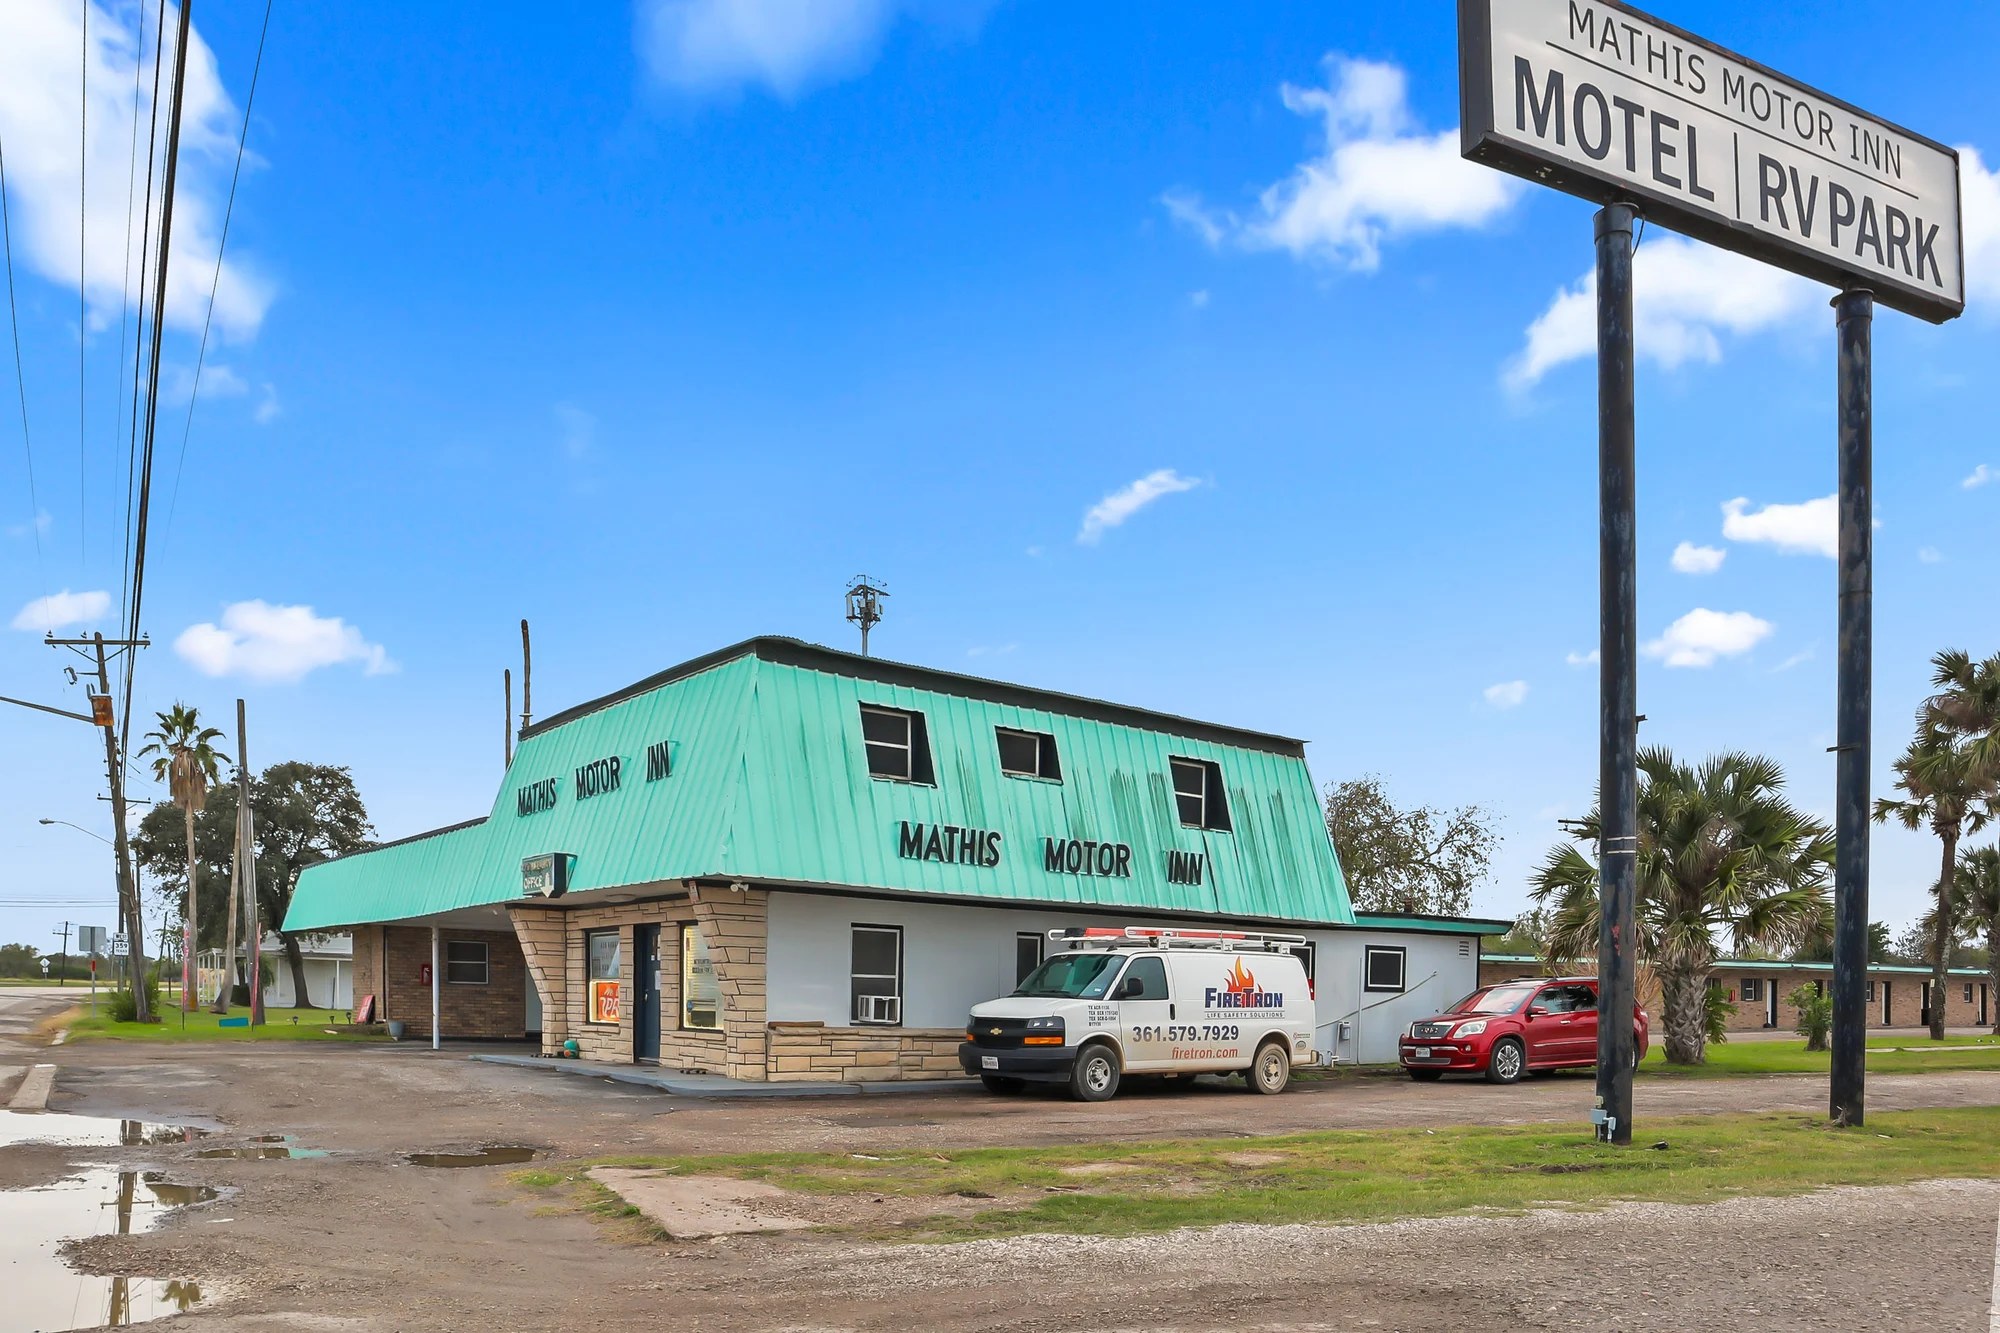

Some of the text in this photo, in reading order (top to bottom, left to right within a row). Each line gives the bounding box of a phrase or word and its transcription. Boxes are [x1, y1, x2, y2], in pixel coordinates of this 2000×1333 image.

[1568, 0, 1902, 180] MATHIS MOTOR INN
[1514, 54, 1943, 288] MOTEL RV PARK
[517, 740, 671, 818] MATHIS MOTOR INN
[523, 875, 543, 890] OFFICE
[899, 820, 1204, 886] MATHIS MOTOR INN
[1132, 1025, 1239, 1042] 361.579.7929
[1171, 1047, 1238, 1060] firetron.com
